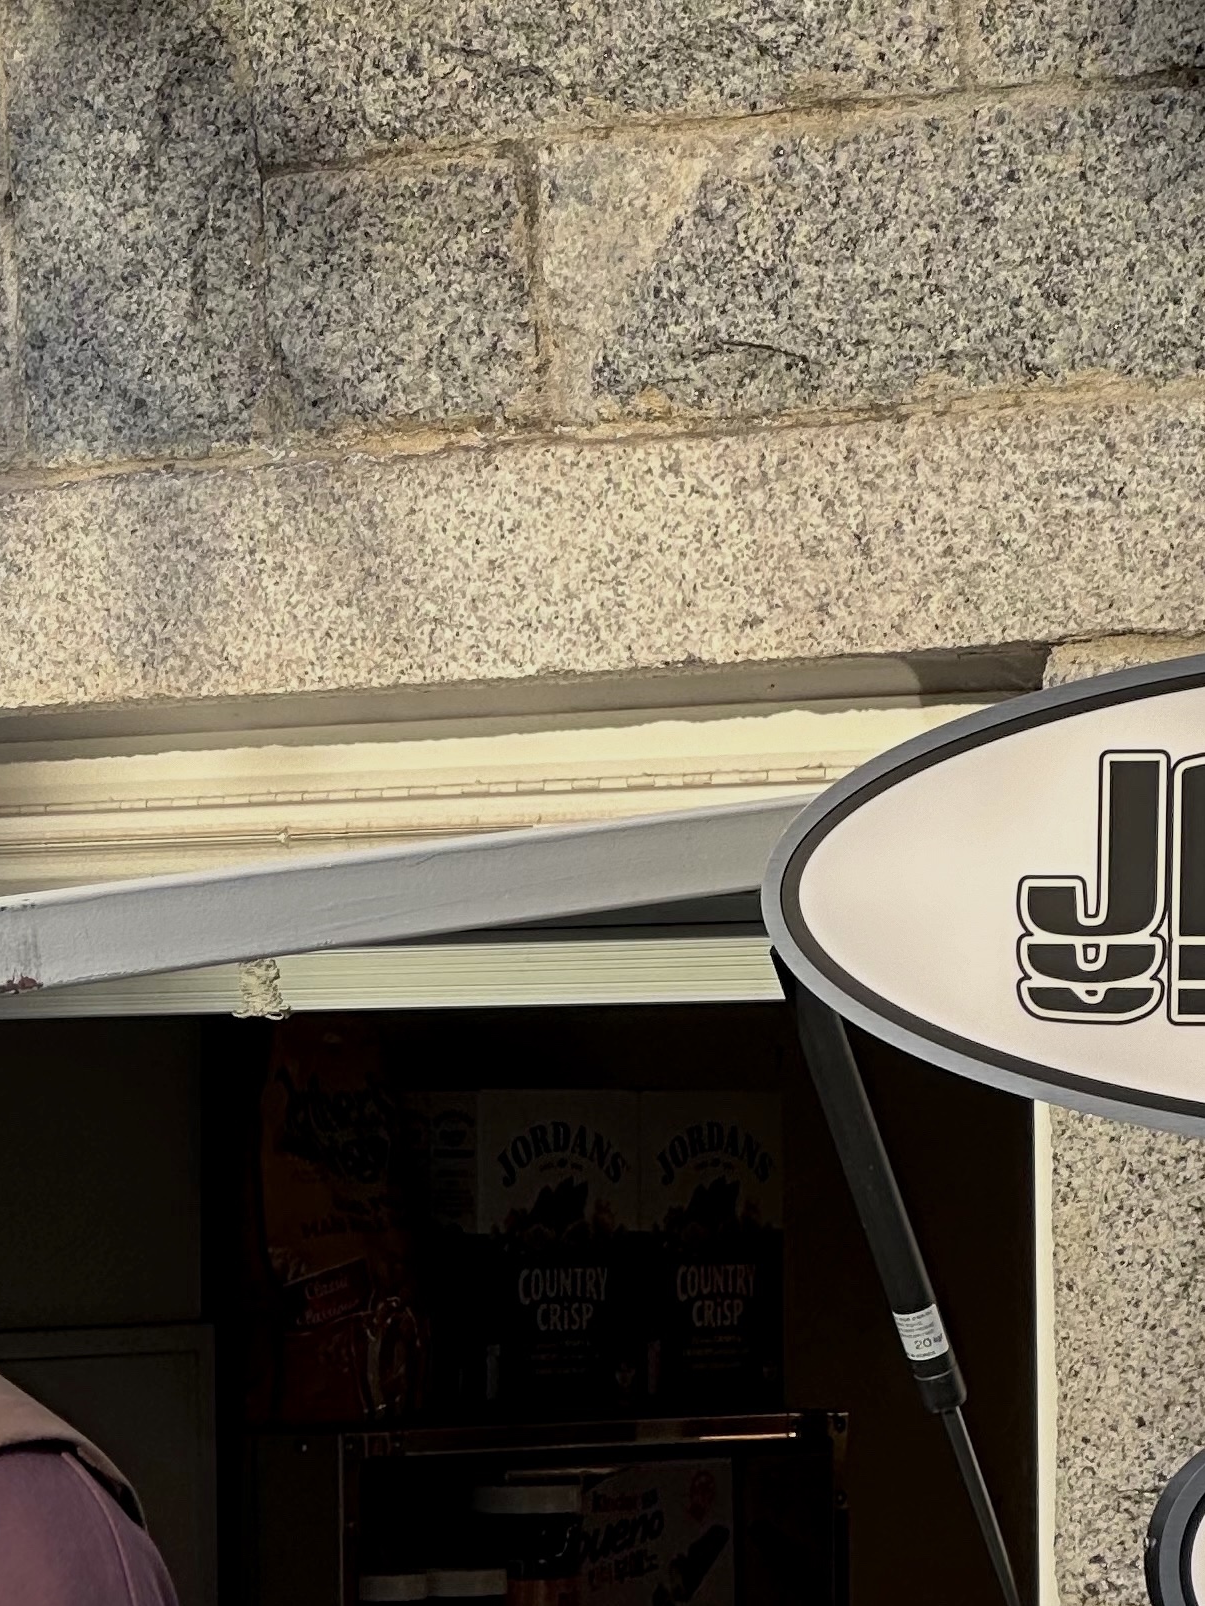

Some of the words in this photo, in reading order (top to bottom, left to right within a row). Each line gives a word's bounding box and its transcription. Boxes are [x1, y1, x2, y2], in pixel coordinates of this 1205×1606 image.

[1017, 750, 1205, 1026] J
[497, 1121, 629, 1187] JORDANS
[657, 1120, 774, 1186] JORDANS
[518, 1266, 608, 1306] COUNTRY
[676, 1264, 757, 1302] COUNTRY
